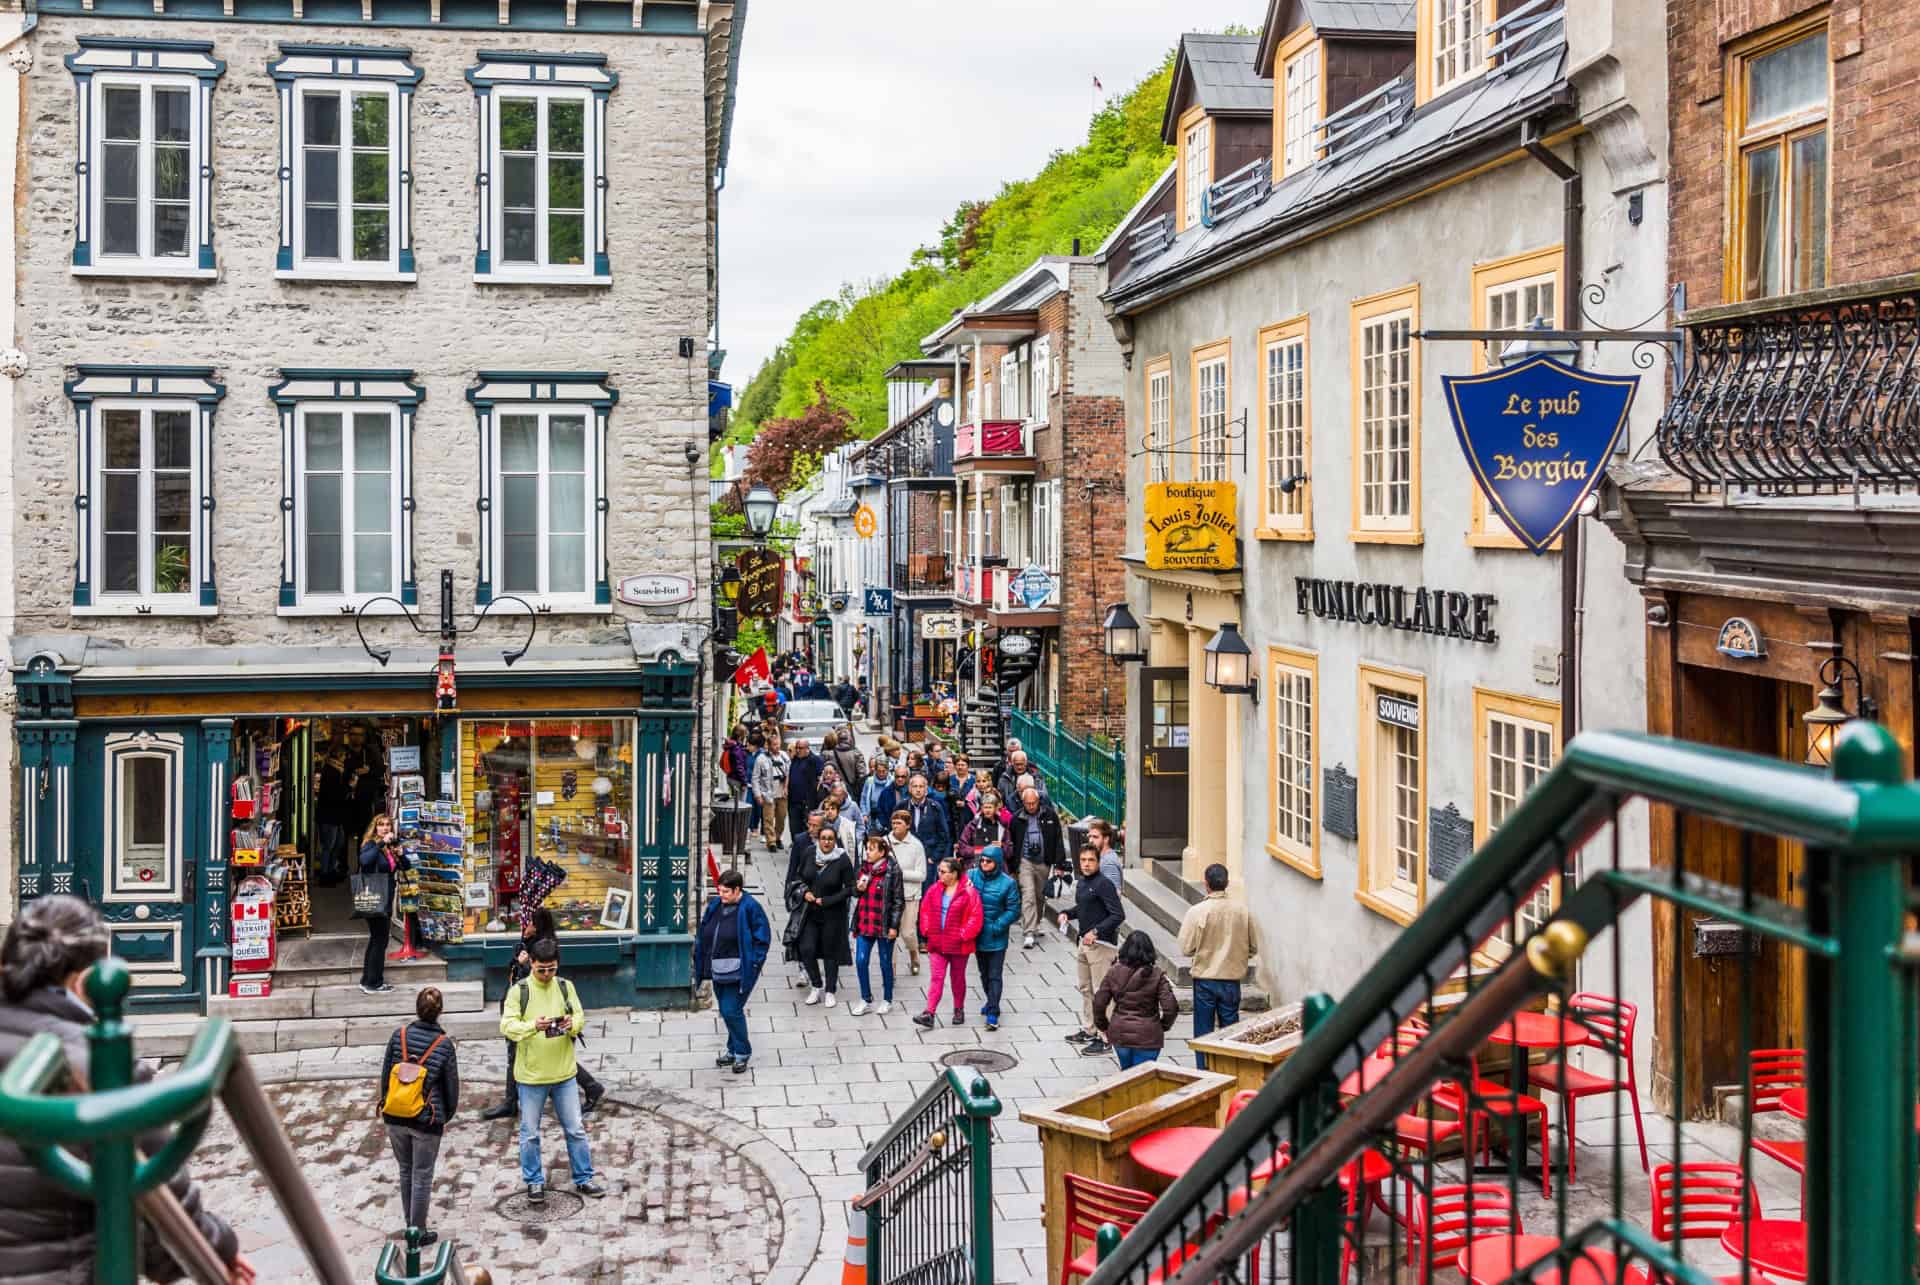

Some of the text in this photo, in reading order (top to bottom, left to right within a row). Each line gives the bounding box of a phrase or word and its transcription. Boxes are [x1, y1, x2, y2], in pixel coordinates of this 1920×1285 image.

[1502, 390, 1580, 420] Le pub
[1523, 424, 1559, 448] des
[1493, 452, 1587, 486] Borgia
[1166, 486, 1216, 499] boutique
[1149, 503, 1235, 535] Louis Jolliet
[1163, 552, 1220, 565] souvenirs
[1295, 576, 1499, 643] FUNICULAIRE
